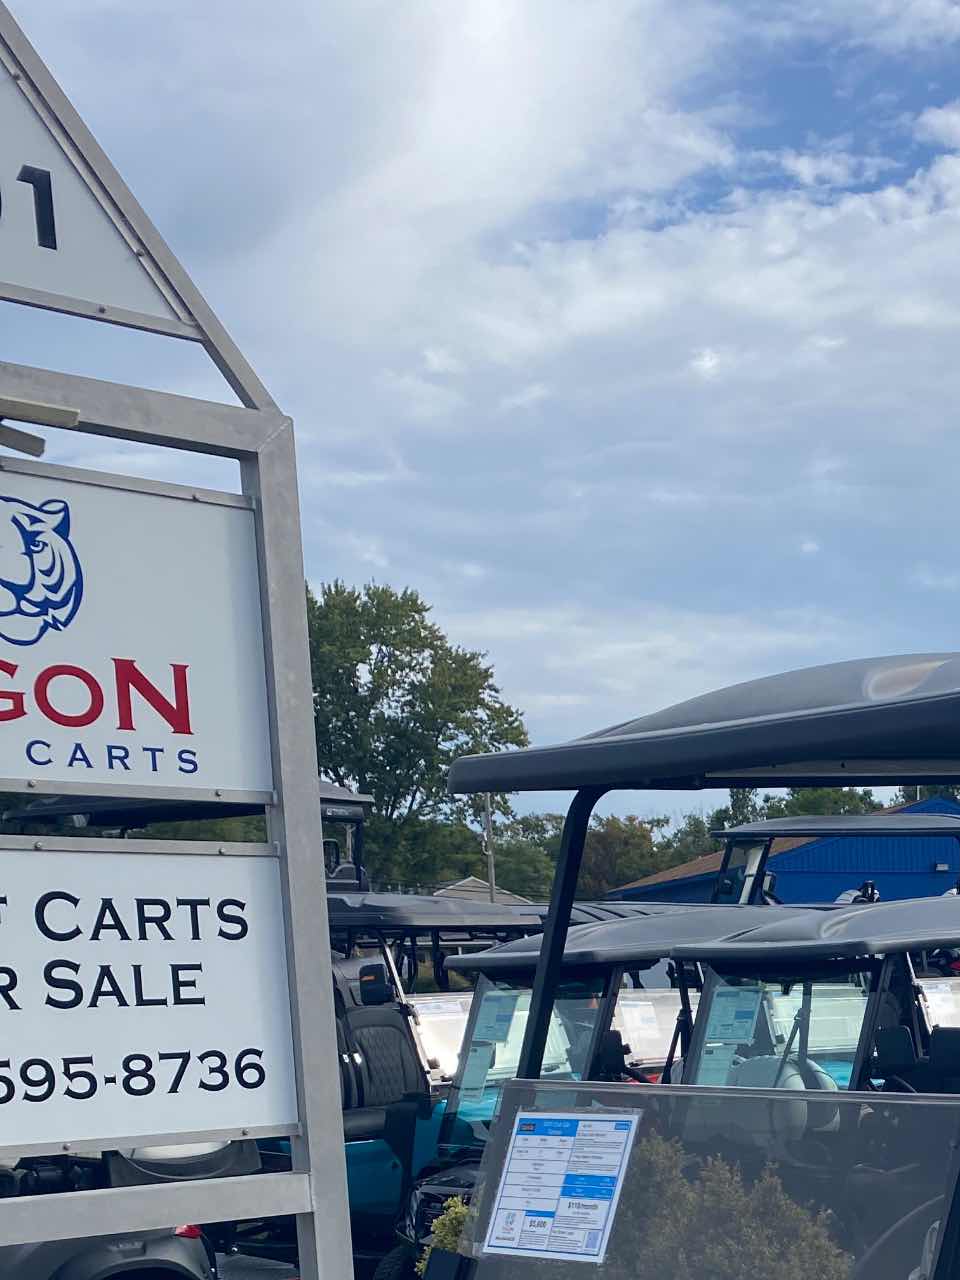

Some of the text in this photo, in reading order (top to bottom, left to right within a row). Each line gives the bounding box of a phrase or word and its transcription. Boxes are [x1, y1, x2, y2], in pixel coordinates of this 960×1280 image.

[0, 164, 57, 250] 1
[25, 739, 199, 774] CARTS
[34, 890, 249, 942] CARTS
[43, 959, 206, 1010] SALE
